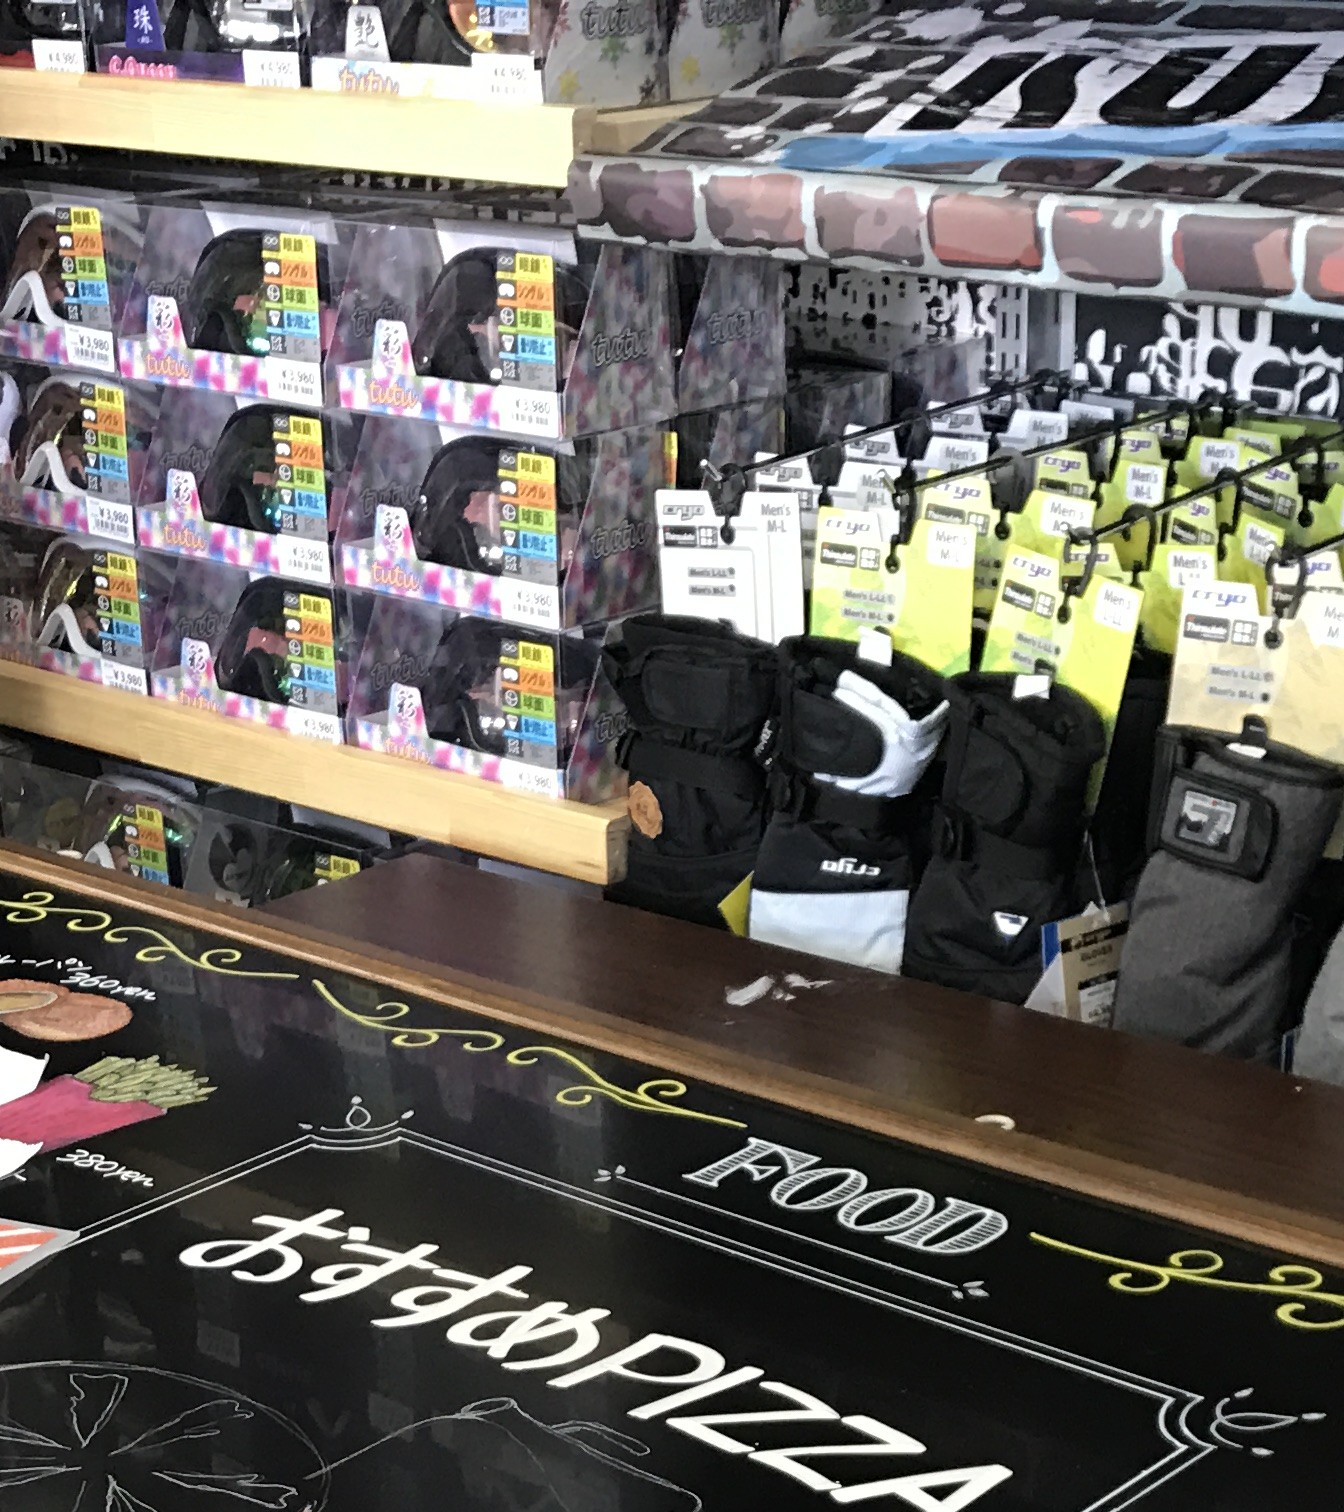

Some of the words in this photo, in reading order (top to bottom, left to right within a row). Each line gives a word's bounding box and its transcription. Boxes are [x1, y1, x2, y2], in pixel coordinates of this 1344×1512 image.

[132, 5, 154, 34] 珠
[144, 354, 193, 378] tutu
[368, 382, 419, 409] tutu
[760, 503, 792, 517] Men's
[163, 526, 207, 550] tutu
[371, 562, 420, 590] tutu
[1191, 590, 1248, 607] cryo
[820, 857, 882, 877] cryo
[60, 972, 157, 1001] 360yen
[55, 1149, 155, 1188] 380yen
[683, 1136, 1008, 1258] FOOD
